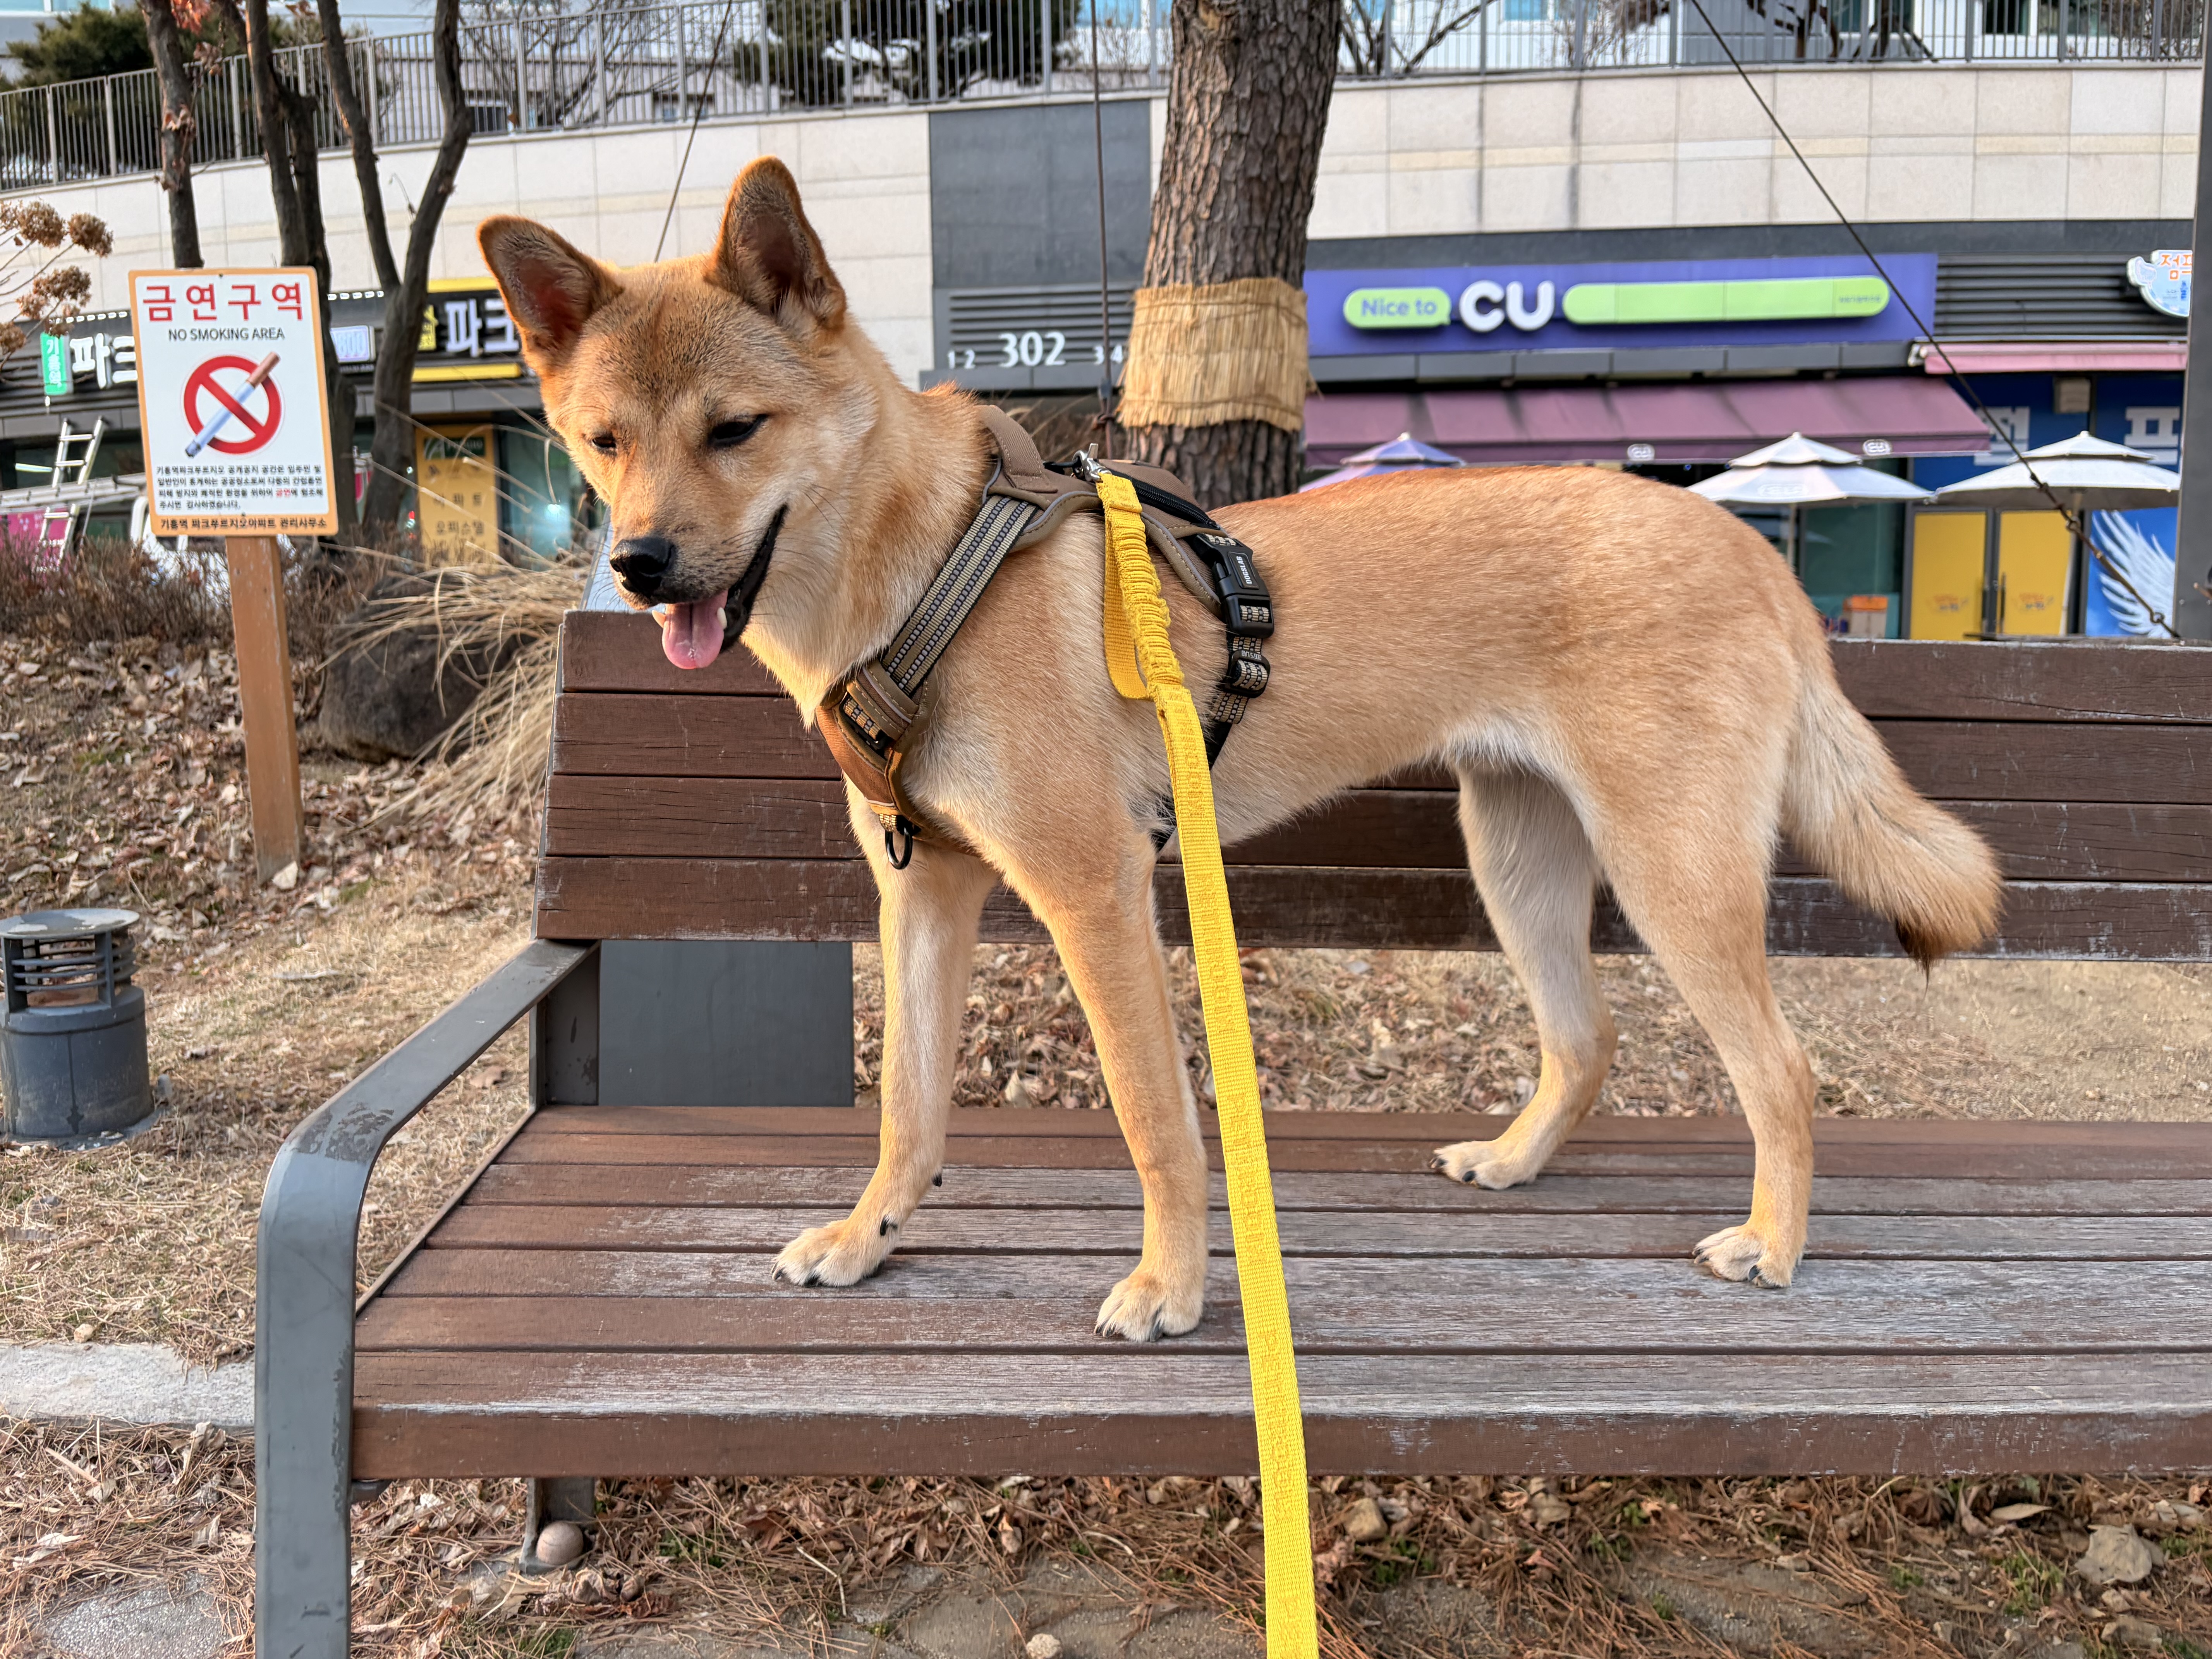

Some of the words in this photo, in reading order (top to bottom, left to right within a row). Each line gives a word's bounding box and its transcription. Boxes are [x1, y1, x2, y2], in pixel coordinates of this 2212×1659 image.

[143, 282, 302, 321] 금연구역
[1361, 298, 1408, 316] Nice
[1415, 298, 1437, 316] to
[1459, 280, 1555, 332] CU
[169, 329, 187, 341] NO
[190, 328, 249, 341] SMOKING
[252, 327, 285, 340] AREA
[998, 331, 1066, 368] 302
[1110, 344, 1123, 363] 4
[948, 350, 955, 369] 1
[964, 349, 975, 369] 2
[156, 465, 224, 476] 기흥역파크푸르지오
[262, 465, 284, 474] 공간은
[288, 465, 311, 474] 입주민
[314, 465, 321, 473] 및
[158, 477, 187, 487] 일반인이
[159, 489, 173, 498] 피해
[276, 488, 298, 498] 금연에
[160, 500, 182, 510] 주시면
[161, 518, 188, 531] 기흥역
[191, 517, 276, 530] 파크푸르지오아파트
[280, 517, 327, 530] 관리사무소
[1236, 556, 1252, 584] DOGSLAB
